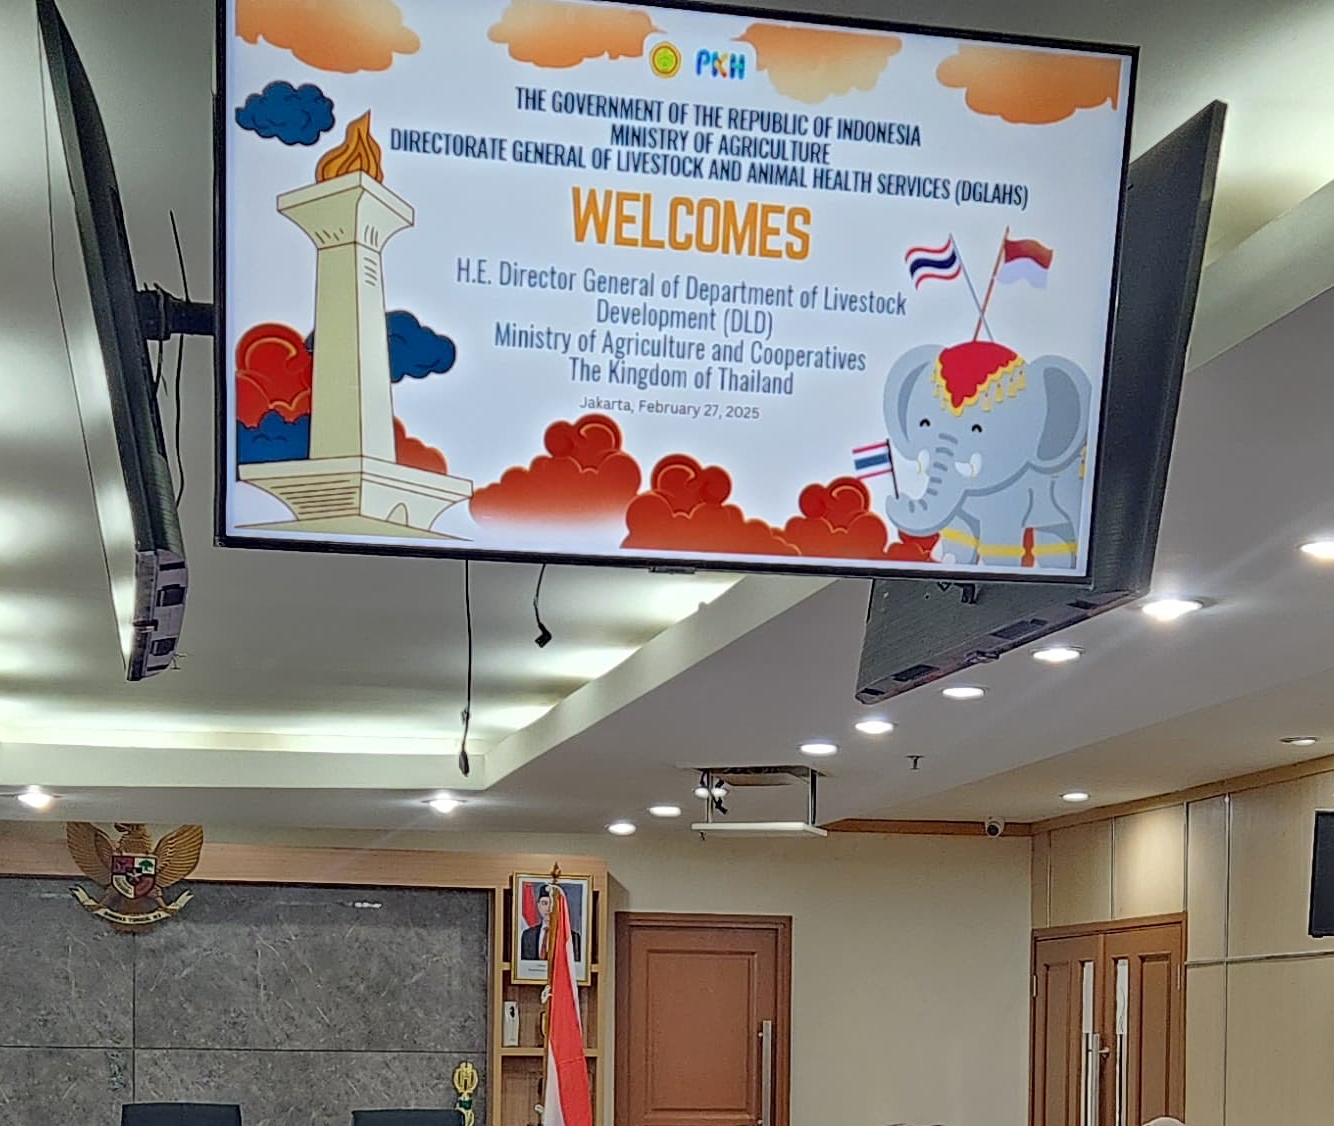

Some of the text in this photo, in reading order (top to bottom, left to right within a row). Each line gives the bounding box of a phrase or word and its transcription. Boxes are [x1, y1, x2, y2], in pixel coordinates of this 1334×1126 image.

[695, 47, 746, 81] PKH
[514, 86, 922, 147] THE GOVERNMENT OF THE REPUBLIC OF INDONESIA
[390, 127, 1029, 210] DIRECTORATE GENERAL OF LIVESTOCK AND ANIMAL HEALTH SERVICES (DGLAHS)
[610, 123, 831, 165] MINISTRY OF AGRICULTURE
[570, 186, 811, 261] WELCOMES
[456, 257, 907, 316] H.E. Director General of Department of Livestock
[596, 298, 773, 341] Development (DLD)
[494, 321, 867, 376] Ministry of Agriculture and Cooperatives
[568, 356, 794, 395] The Kingdom of Thailand
[579, 394, 760, 420] Jakarta, February 27, 2025
